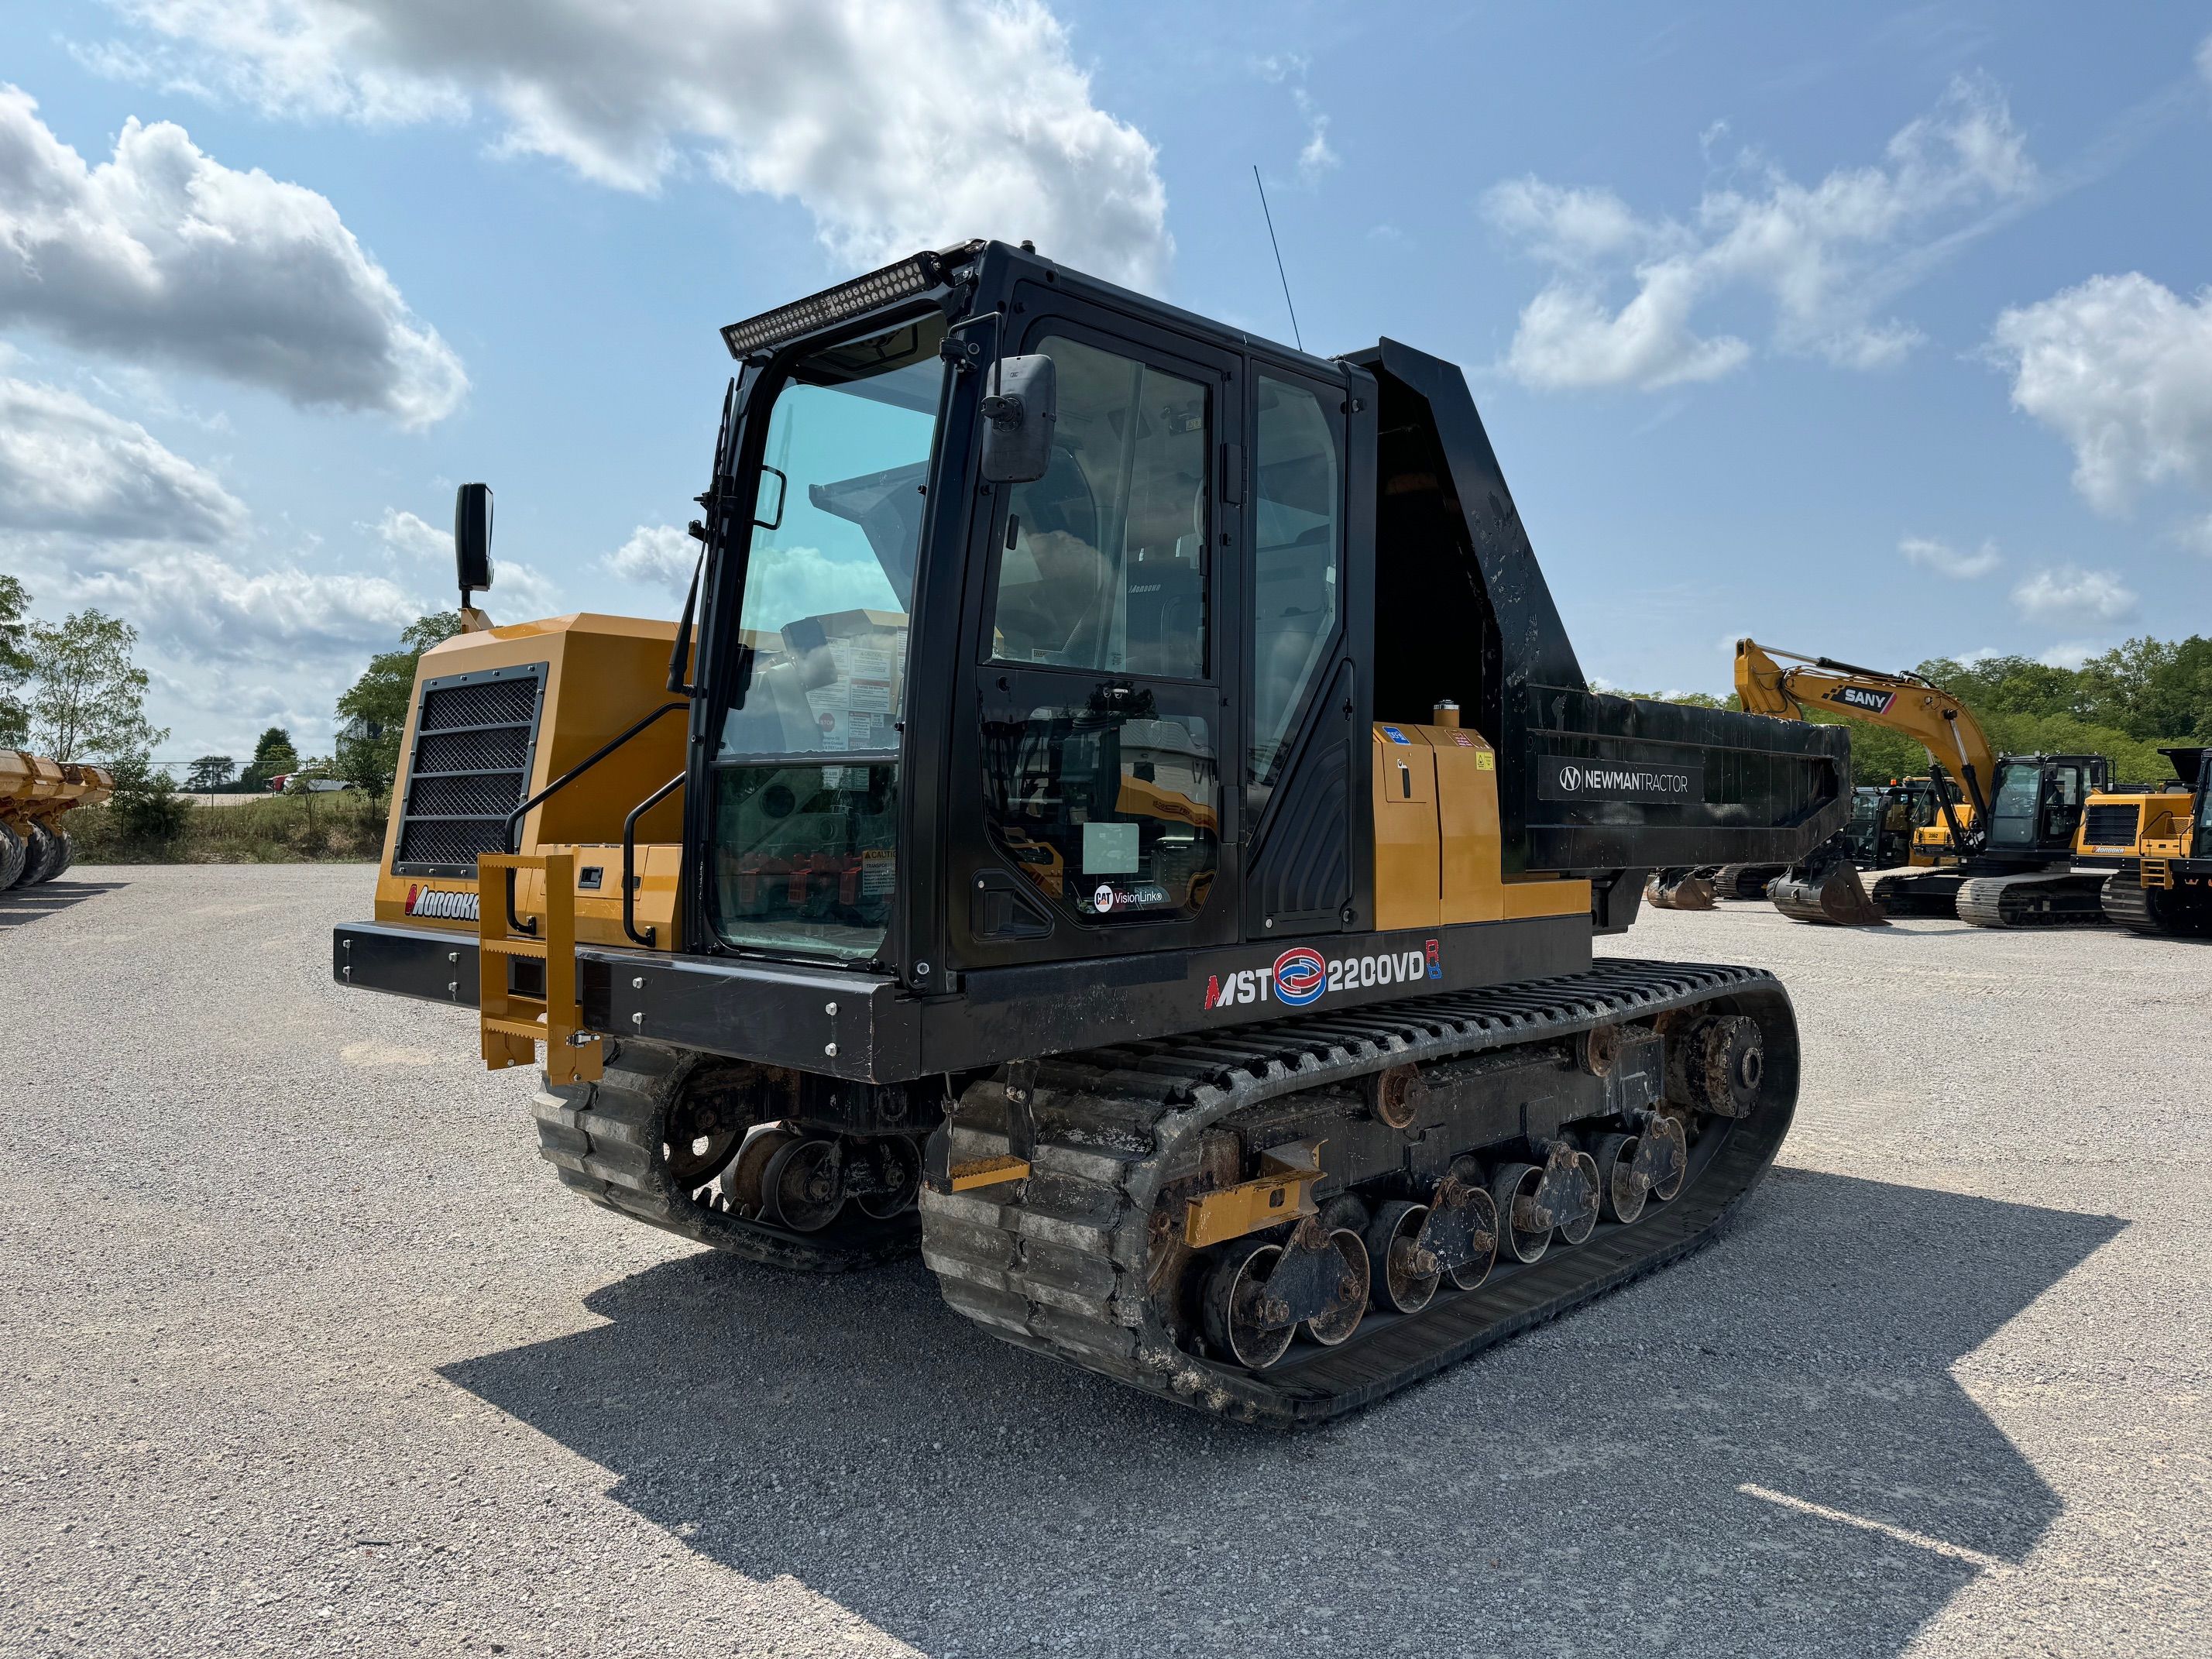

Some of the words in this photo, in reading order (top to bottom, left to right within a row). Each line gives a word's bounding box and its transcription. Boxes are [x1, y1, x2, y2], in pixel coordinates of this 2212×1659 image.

[1845, 689, 1886, 708] SANY
[1585, 770, 1688, 792] NEWMANTRACTOR
[1095, 892, 1111, 905] CAT
[1204, 967, 1273, 1010] MST
